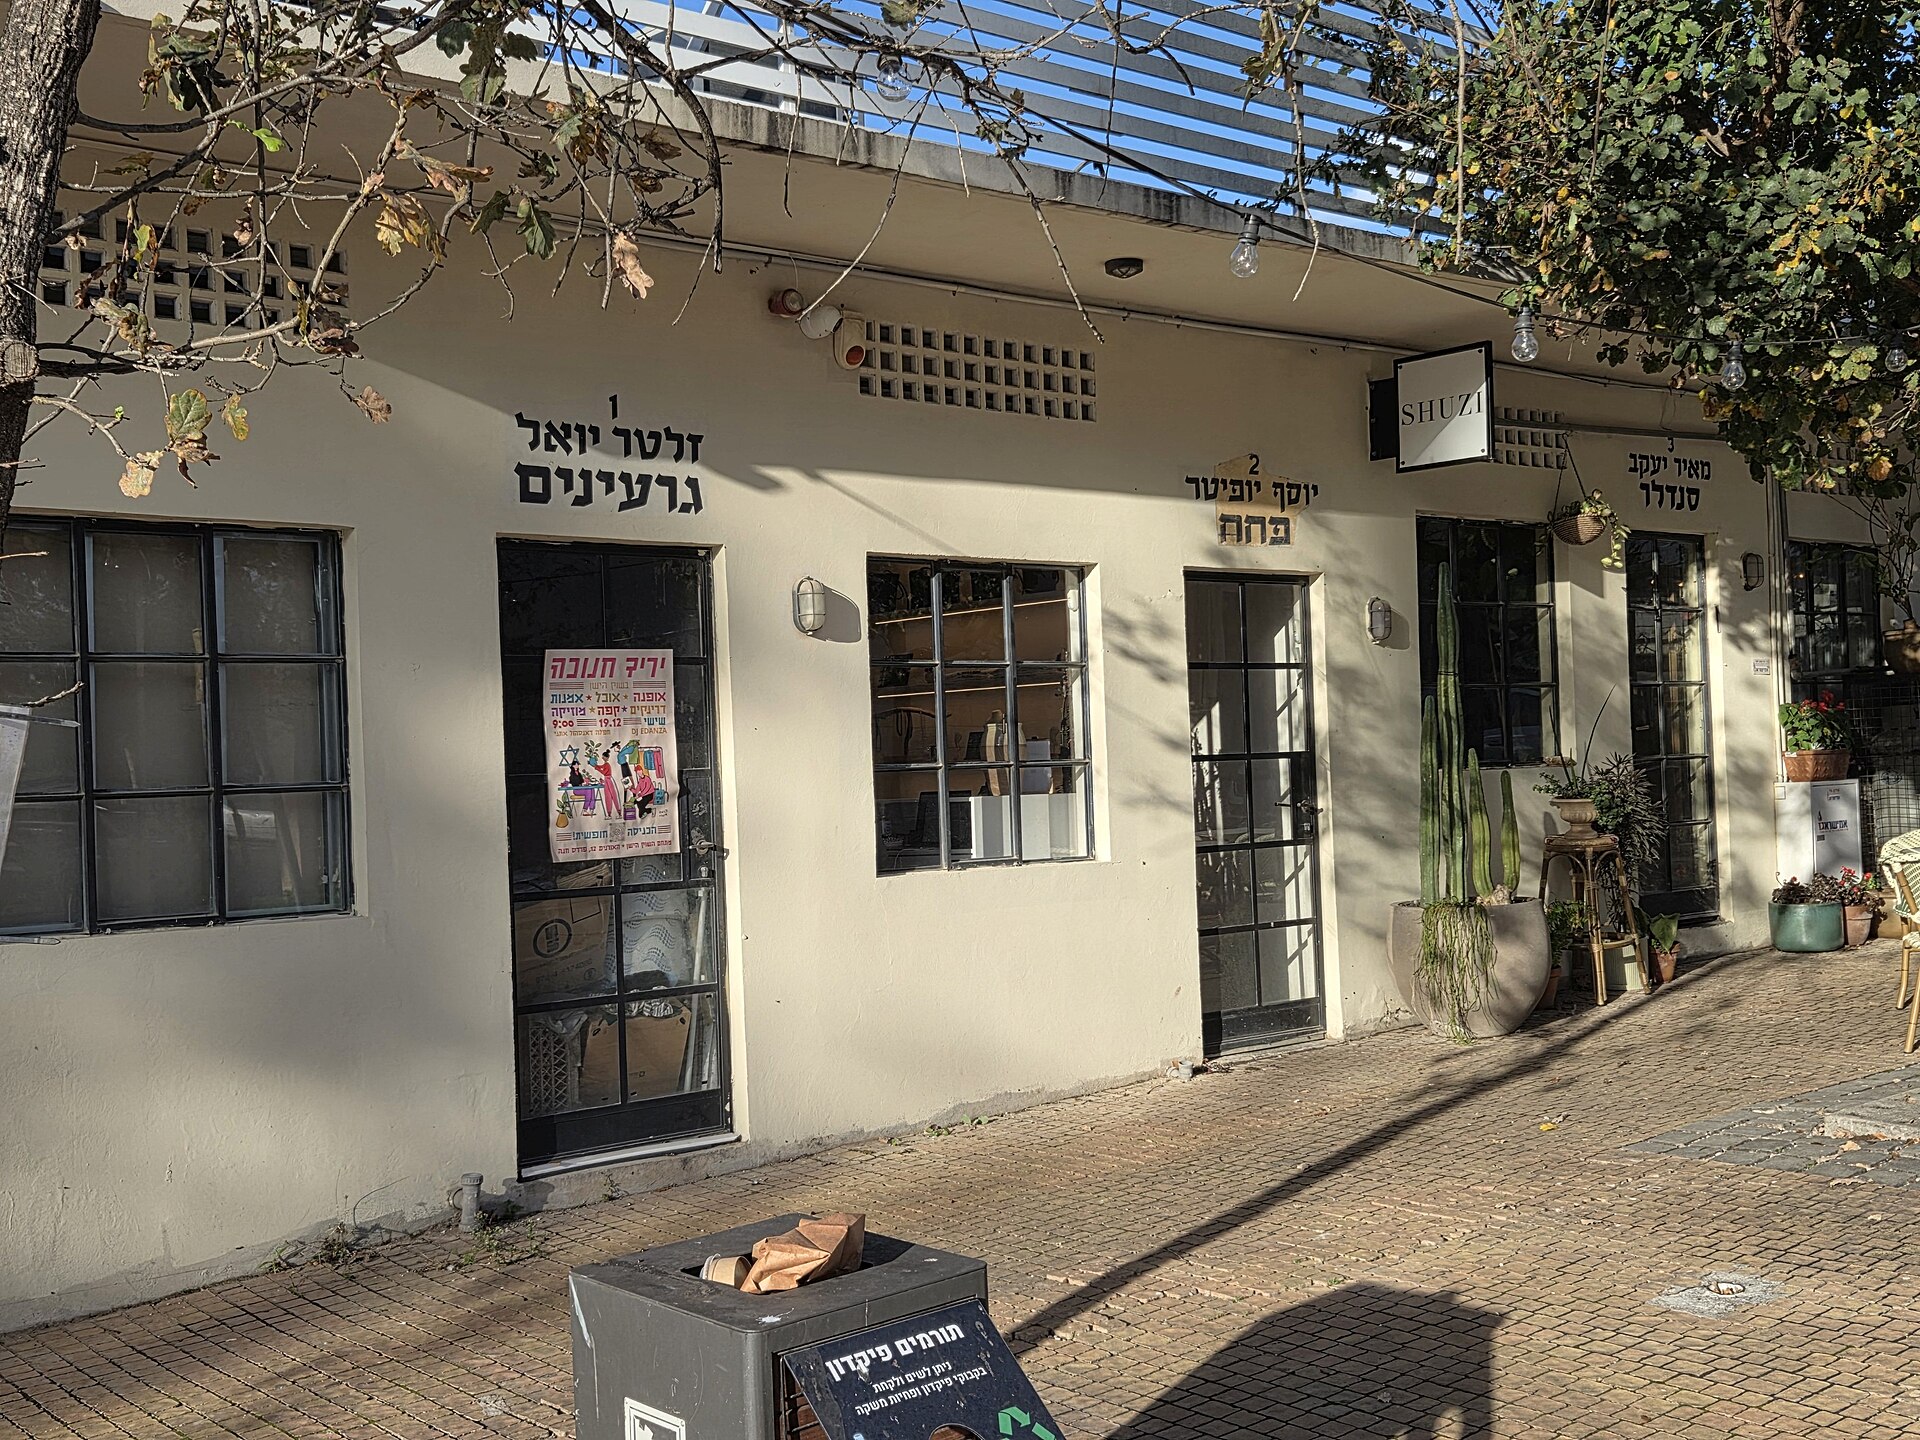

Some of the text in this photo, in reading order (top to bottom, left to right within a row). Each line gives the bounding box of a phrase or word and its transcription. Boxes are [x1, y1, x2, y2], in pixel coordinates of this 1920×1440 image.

[1401, 391, 1483, 425] SHUZI
[514, 411, 704, 464] זלטר יואל
[1667, 436, 1675, 453] 3
[1248, 453, 1260, 475] 2
[1628, 452, 1711, 480] מאיר יעקב
[513, 461, 704, 515] גרעינים
[1185, 475, 1319, 513] יוסף יופיטר
[1639, 479, 1700, 511] סנדלר
[551, 657, 666, 679] יריד חנוכה
[550, 691, 666, 704] אופנה אוכל אמנות
[589, 681, 629, 691] בשוק הישן
[551, 705, 666, 718] דרינקים קפה מוזיקה
[552, 717, 666, 729] שישי 19.12 9:00
[631, 727, 668, 736] DJ EDANZA
[573, 826, 657, 840] הכניסה חופשית!
[825, 1323, 965, 1382] תורמים פיקדון
[872, 1361, 953, 1394] ניתן לשים ולקחת
[855, 1366, 988, 1416] בקבוקי פיקדון ופחיות משקה
